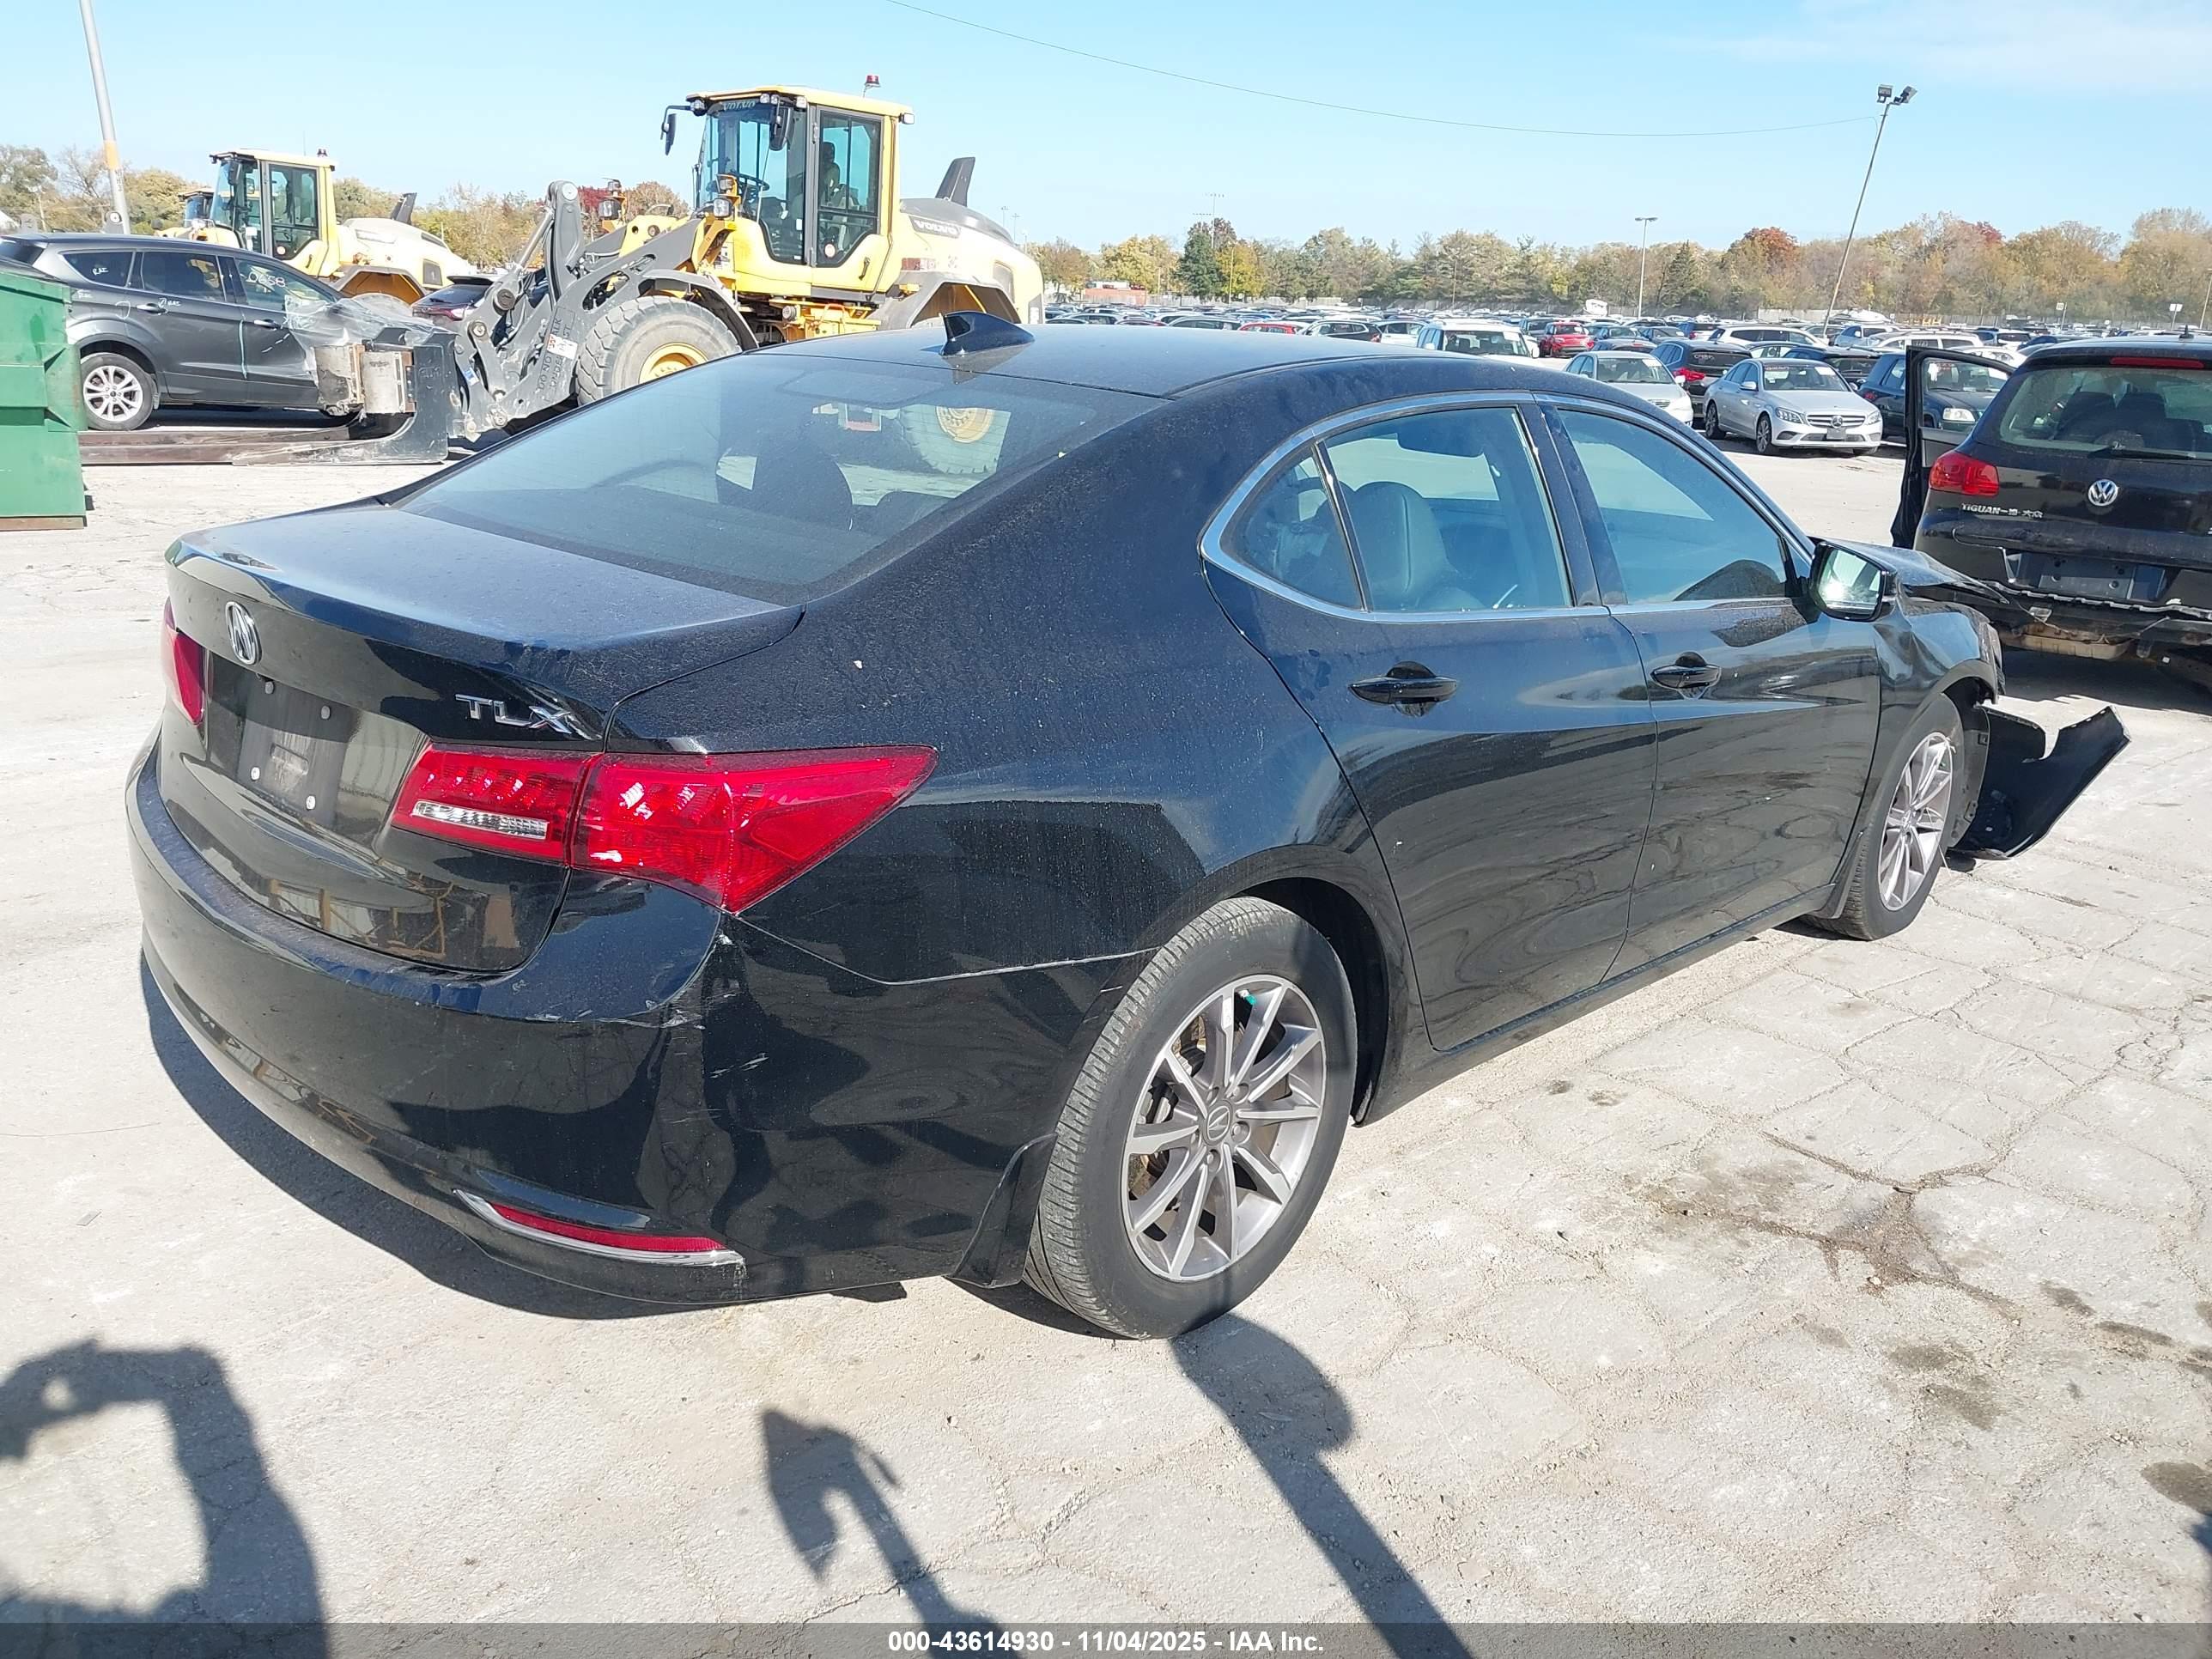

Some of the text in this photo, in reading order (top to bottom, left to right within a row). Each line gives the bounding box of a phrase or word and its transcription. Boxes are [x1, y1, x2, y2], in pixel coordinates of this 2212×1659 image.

[724, 100, 756, 111] VOLVO
[913, 219, 959, 235] VOLVO
[454, 693, 573, 734] TLX
